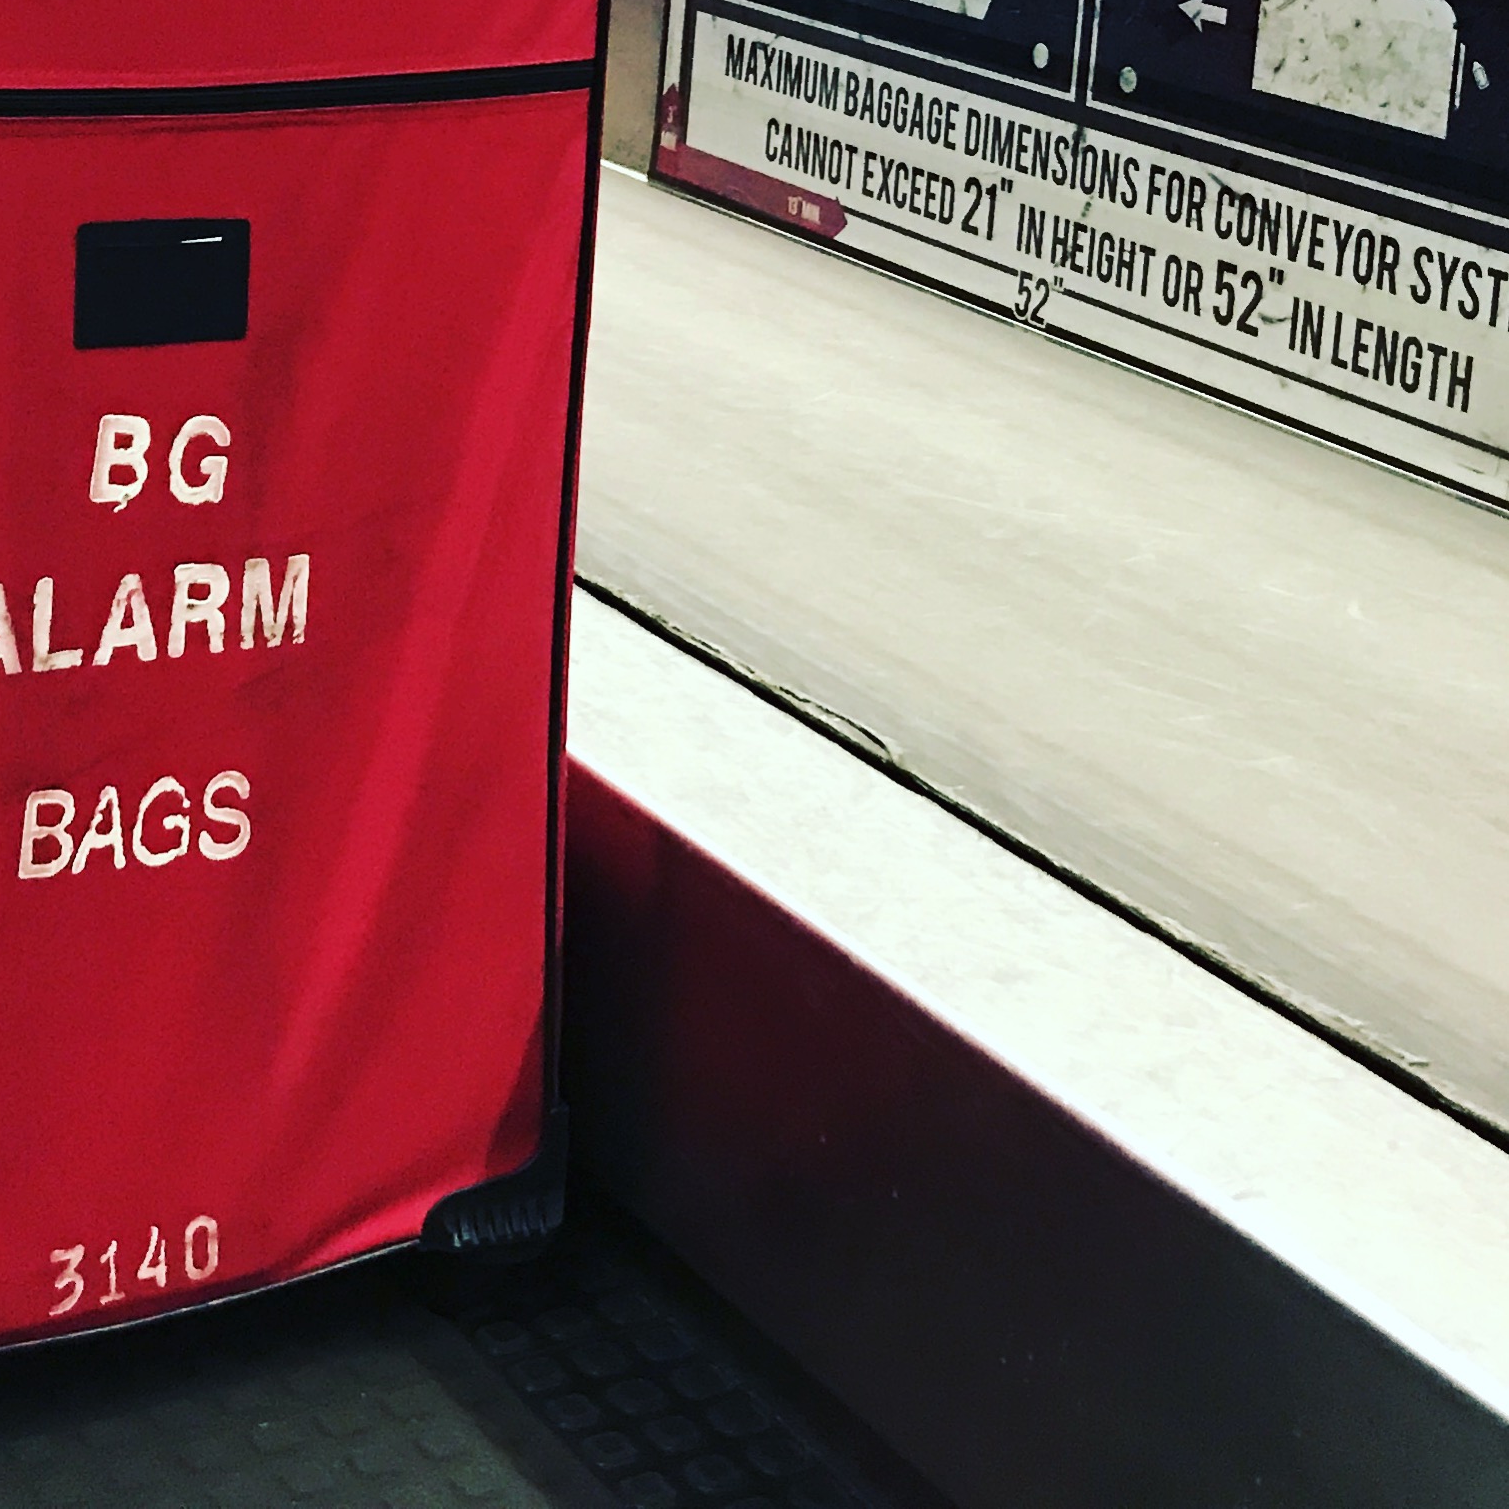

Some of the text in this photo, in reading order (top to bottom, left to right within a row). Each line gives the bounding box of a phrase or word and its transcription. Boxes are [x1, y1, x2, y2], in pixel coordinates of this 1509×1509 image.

[724, 34, 841, 112] MAXIMUM
[844, 71, 960, 150] BAGGAGE
[964, 108, 1140, 209] DIMENSIONS
[1146, 164, 1207, 232] FOR
[1215, 185, 1401, 295] CONVEYOR
[763, 117, 859, 191] CANNOT
[862, 151, 956, 225] EXCEED
[1017, 203, 1046, 260] IN
[1050, 215, 1157, 297] HEIGHT
[1163, 255, 1204, 316] OR
[1289, 297, 1325, 360] IN
[1331, 311, 1474, 413] LENGTH
[89, 413, 231, 509] BG
[18, 770, 252, 879] BAGS
[48, 1214, 219, 1317] 3140
